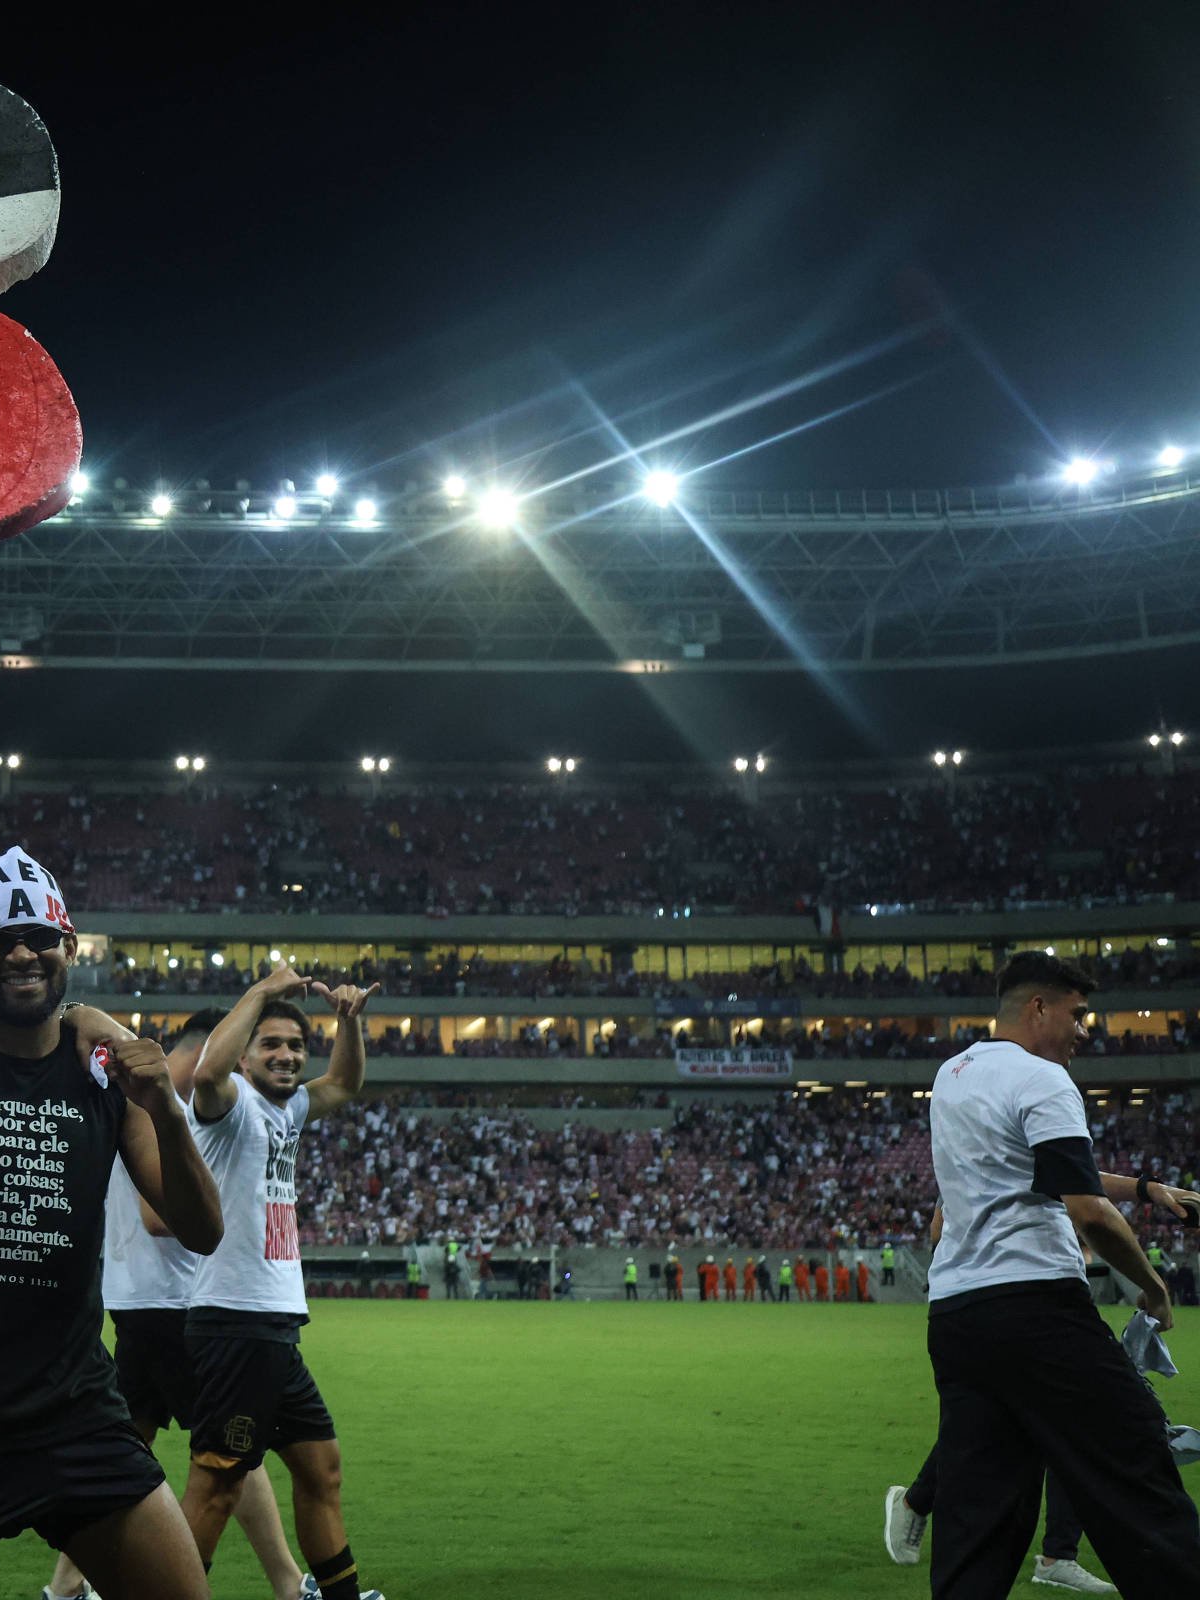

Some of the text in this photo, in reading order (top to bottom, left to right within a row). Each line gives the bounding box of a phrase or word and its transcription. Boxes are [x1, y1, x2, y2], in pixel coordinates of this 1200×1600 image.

[38, 1099, 84, 1123] dele,
[29, 1115, 58, 1134] ele
[39, 1135, 69, 1154] ele
[16, 1153, 65, 1173] todas
[3, 1170, 64, 1194] coisas;
[28, 1192, 73, 1215] pois,
[10, 1208, 38, 1227] ele
[31, 1278, 58, 1288] 11:36
